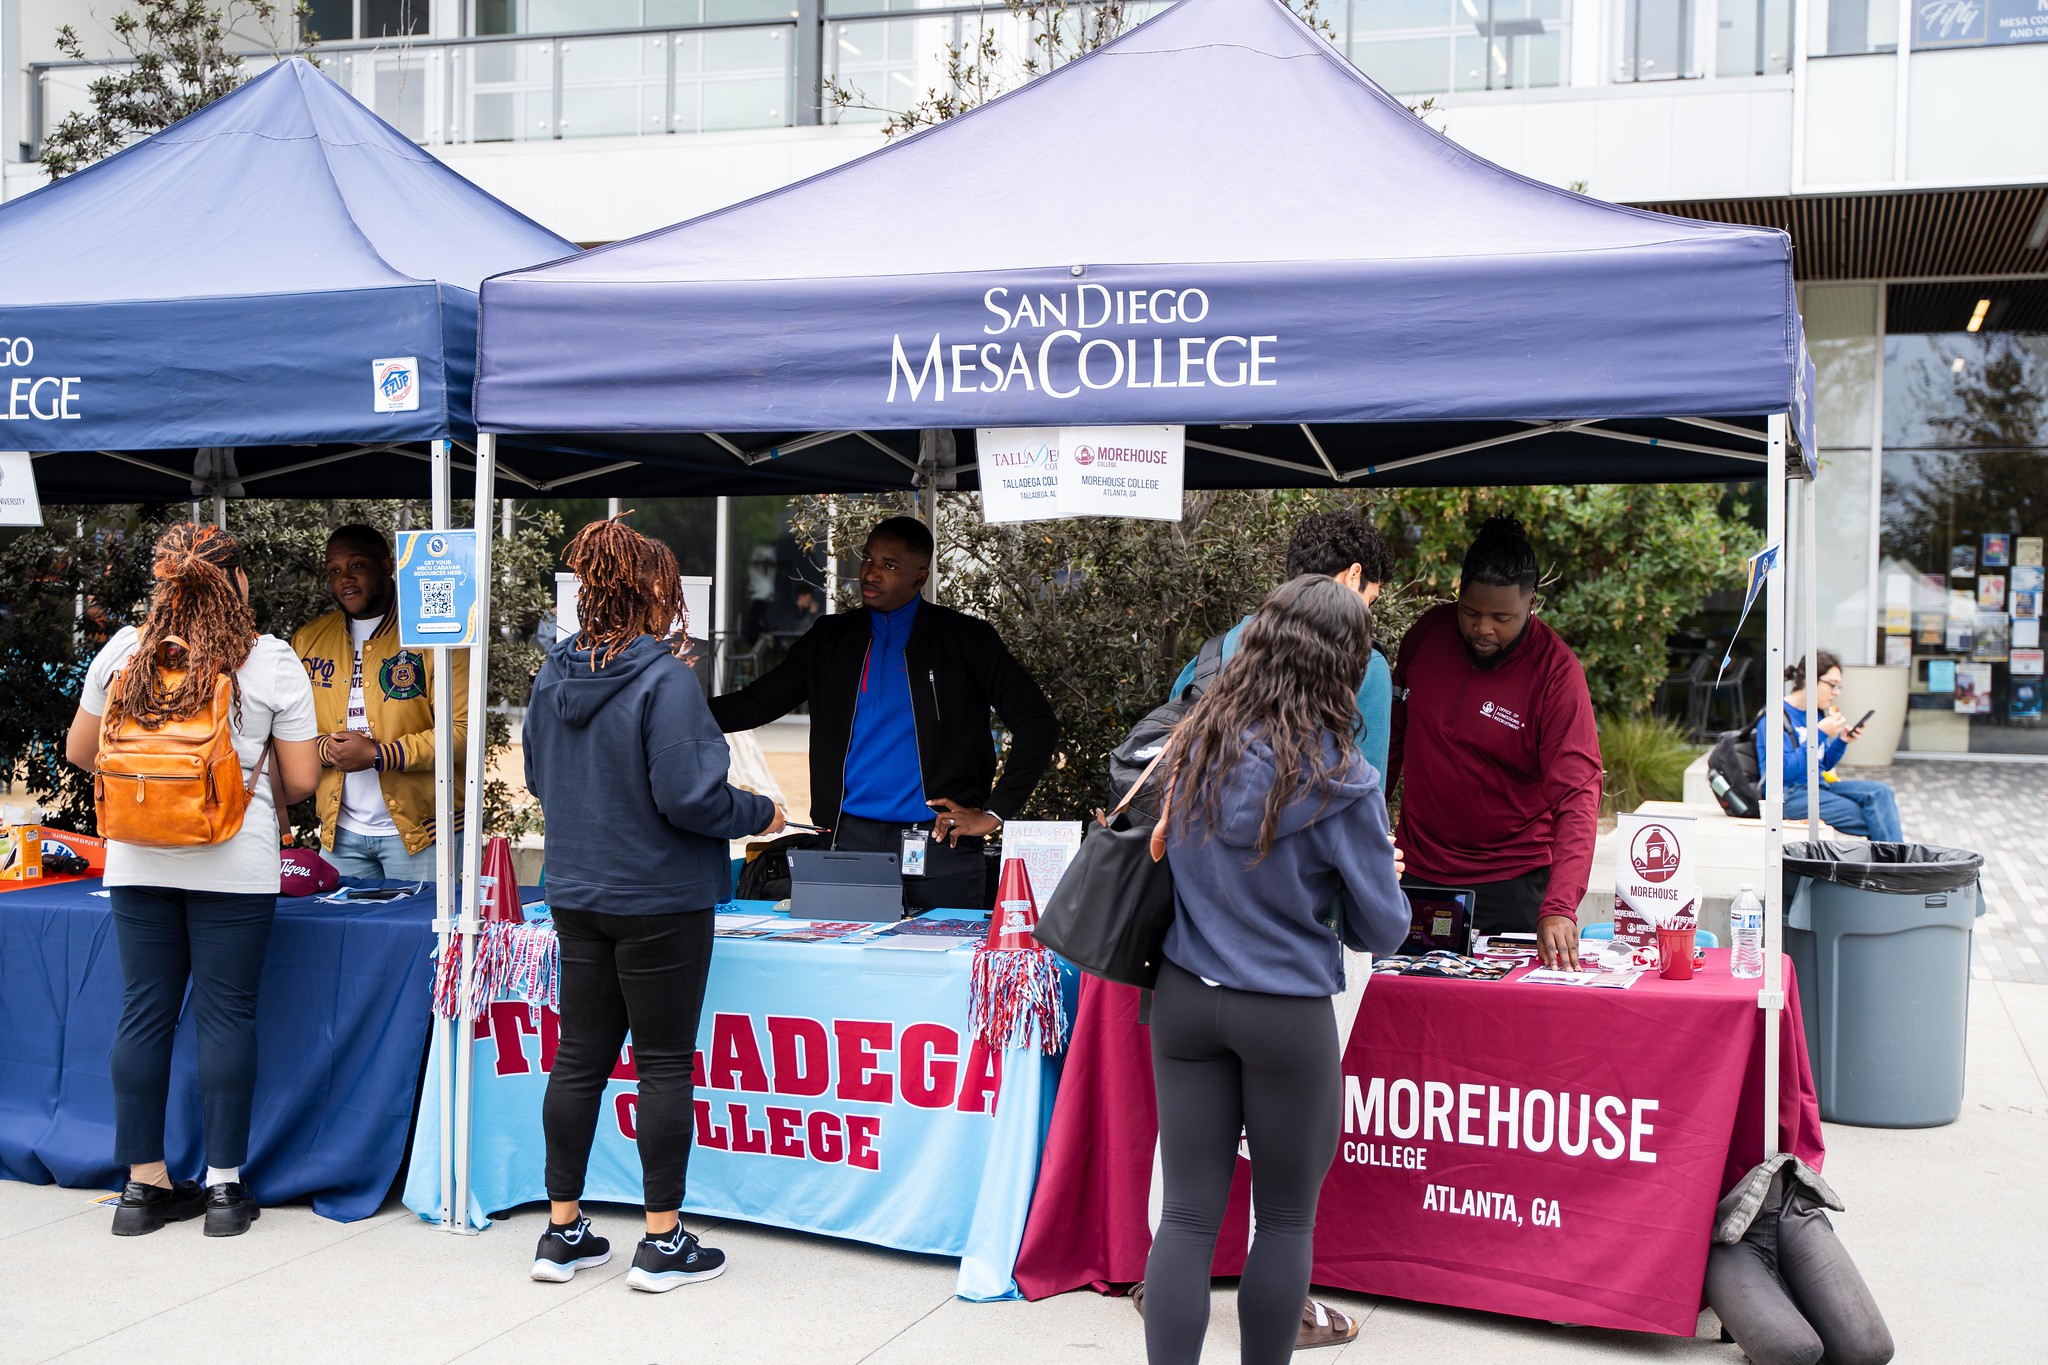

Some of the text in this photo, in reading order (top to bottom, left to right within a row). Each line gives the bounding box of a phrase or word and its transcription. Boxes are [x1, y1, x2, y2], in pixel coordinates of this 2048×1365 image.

[1999, 17, 2029, 28] MESA
[2010, 28, 2033, 39] AND
[992, 441, 1059, 467] TALLADE
[1097, 446, 1167, 464] MOREHOUSE
[1002, 477, 1041, 489] TALLADEGA
[1081, 475, 1159, 490] MOREHOUSE COLLEGE
[1020, 490, 1050, 500] TALLADEGA,
[1103, 488, 1137, 498] ATLANTA, GA
[280, 858, 311, 877] Tigers
[1630, 885, 1679, 901] MOREHOUSE
[1613, 933, 1641, 944] MOREHOUSE
[1344, 1075, 1659, 1163] MOREHOUSE
[613, 1091, 882, 1171] CLLEGE
[1343, 1141, 1427, 1170] COLLEGE
[1423, 1184, 1561, 1228] ATLANTA, GA
